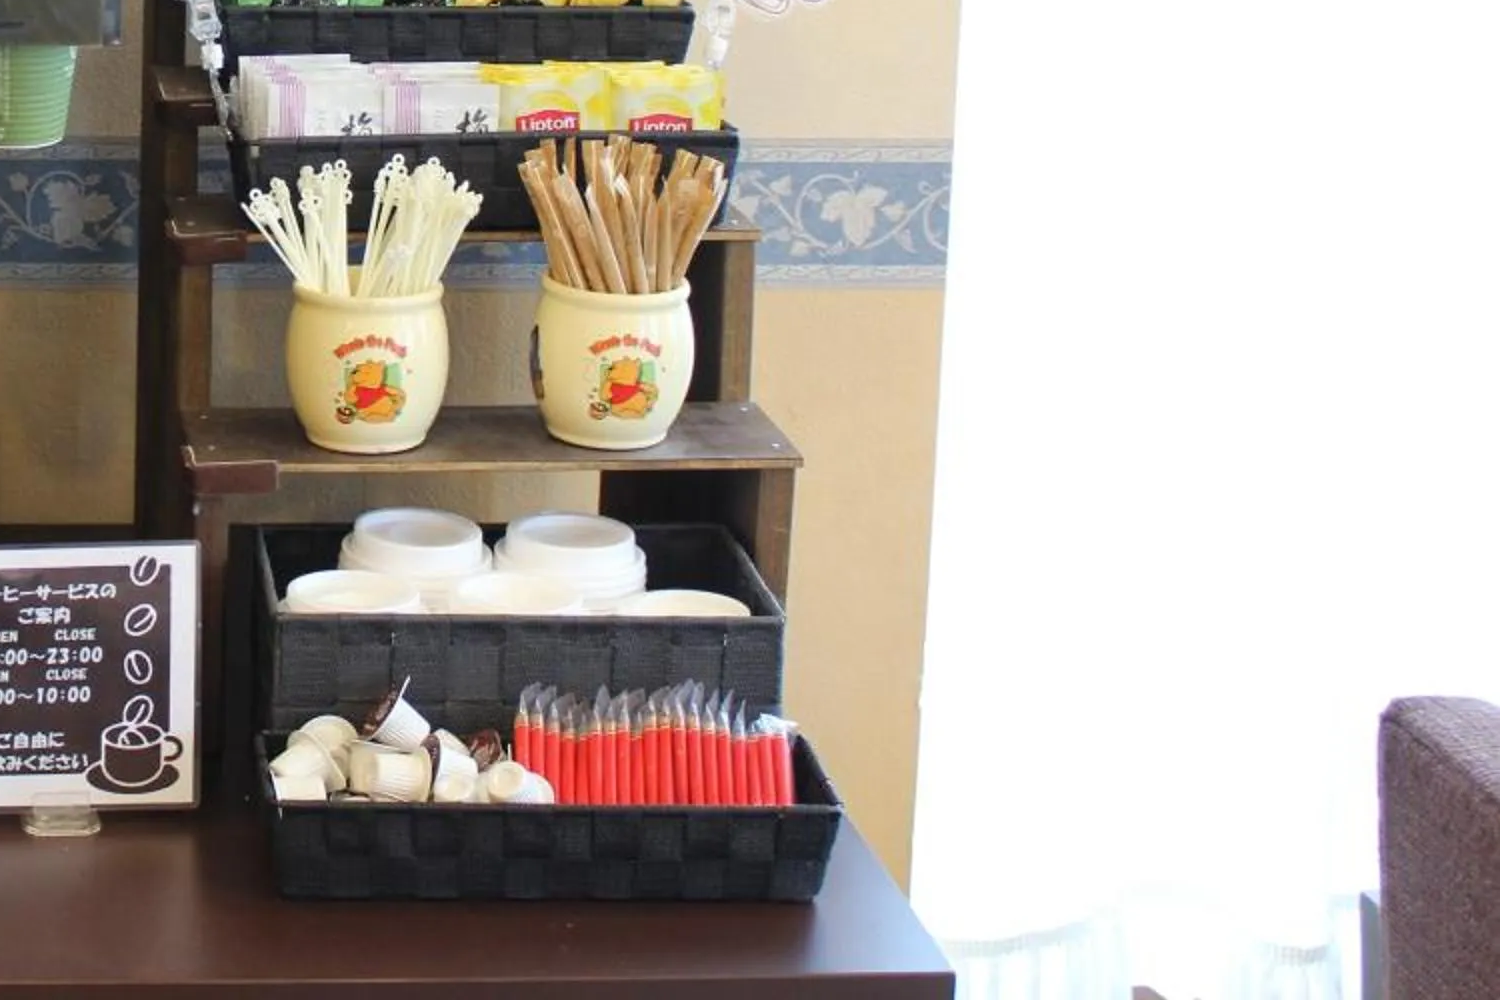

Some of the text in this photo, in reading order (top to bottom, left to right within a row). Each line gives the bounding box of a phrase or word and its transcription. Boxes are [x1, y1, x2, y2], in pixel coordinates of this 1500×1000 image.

[520, 115, 576, 132] Lipton
[17, 606, 71, 625] ご案内
[55, 628, 96, 642] CLOSE
[45, 668, 87, 682] CLOSE
